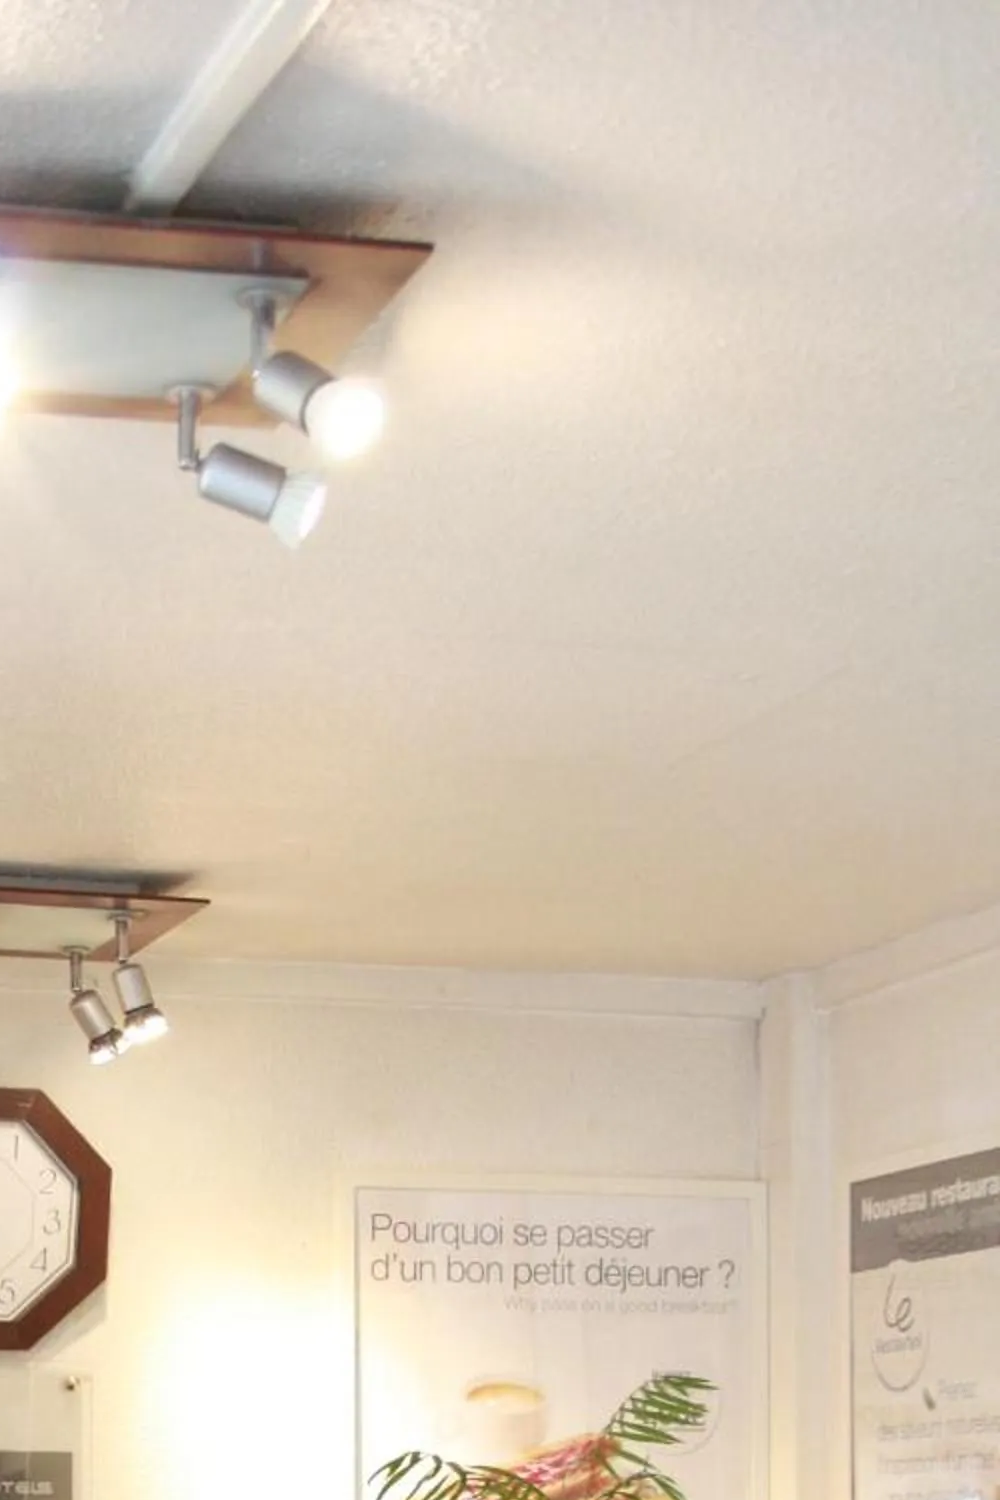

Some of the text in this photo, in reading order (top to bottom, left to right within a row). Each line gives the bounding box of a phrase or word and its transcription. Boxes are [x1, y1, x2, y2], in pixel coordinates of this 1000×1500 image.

[13, 1134, 20, 1161] 1
[39, 1168, 57, 1195] 2
[861, 1190, 927, 1223] Nouveau
[43, 1208, 62, 1236] 3
[371, 1213, 655, 1253] Pourquoi se passer
[29, 1246, 47, 1272] 4
[370, 1252, 736, 1294] d'un bon petit déjeuner ?
